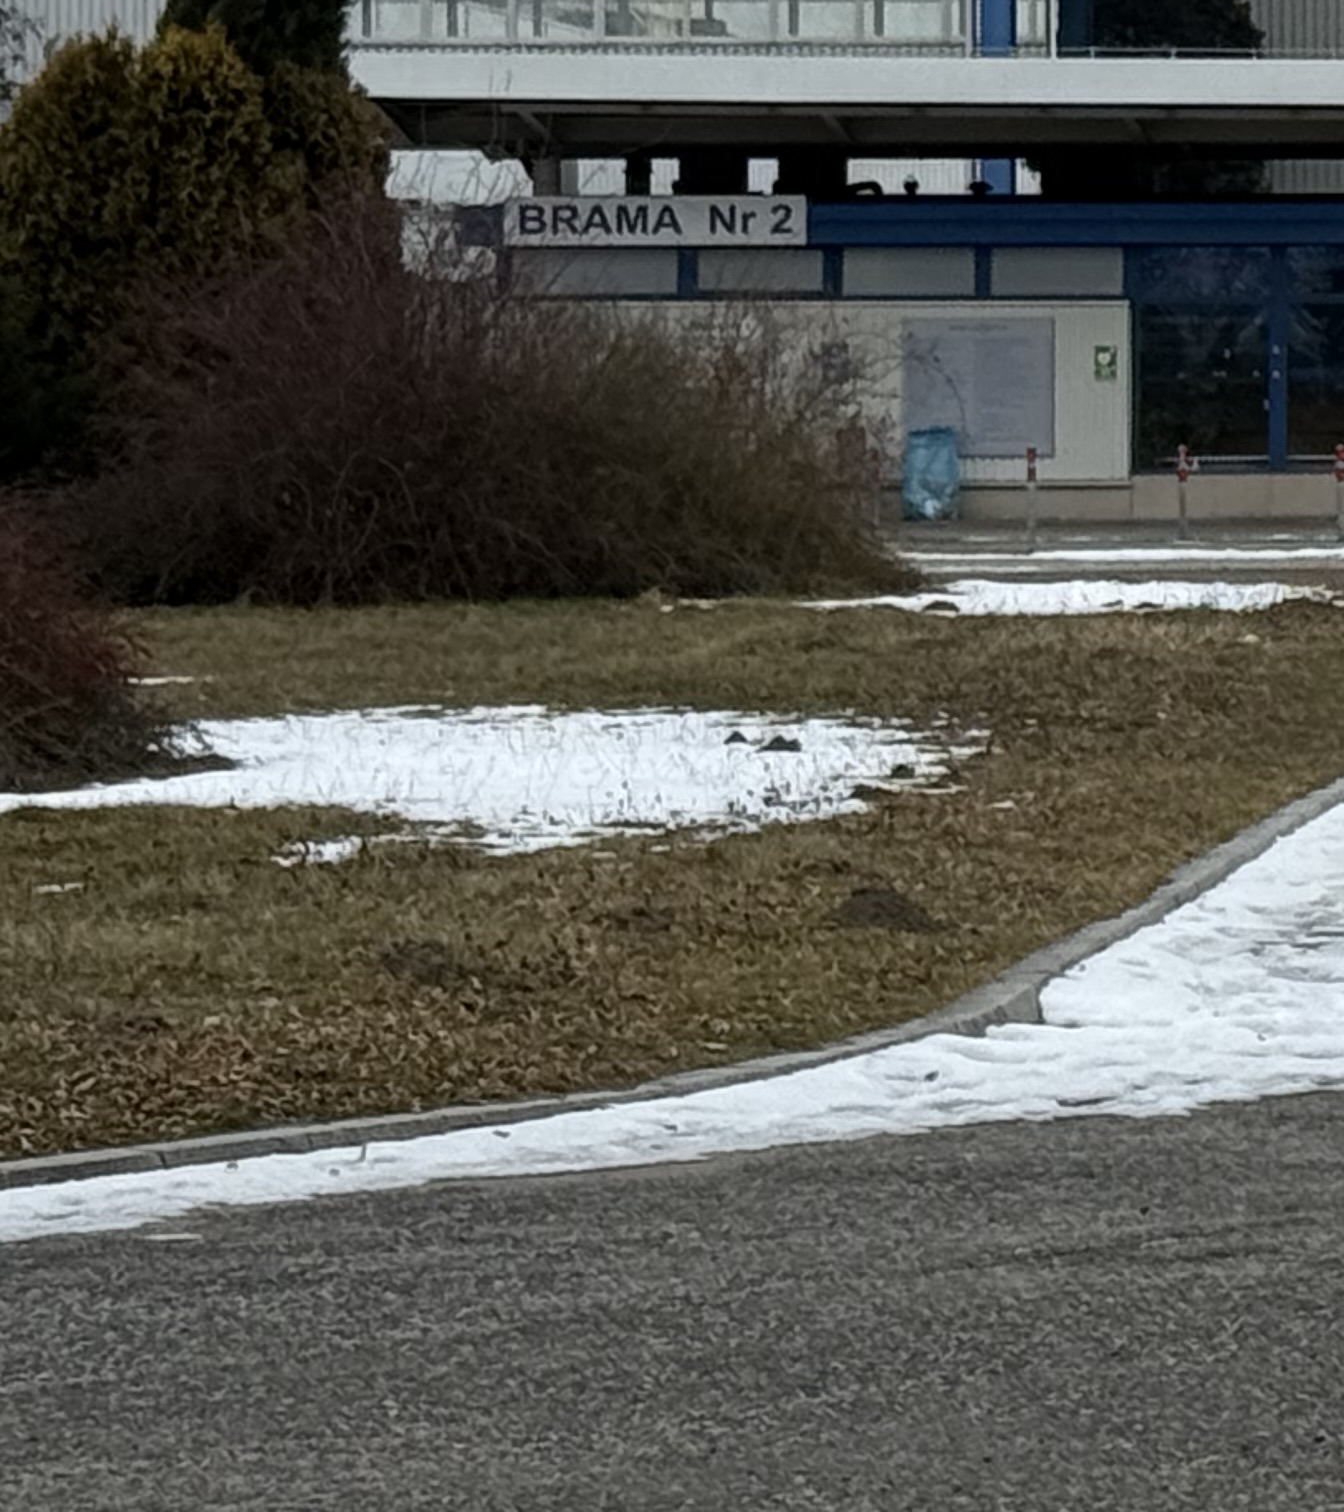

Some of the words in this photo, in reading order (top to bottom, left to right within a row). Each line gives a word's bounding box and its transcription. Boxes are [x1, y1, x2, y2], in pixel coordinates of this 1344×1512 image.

[517, 203, 683, 237] BRAMA
[708, 203, 757, 237] Nr
[769, 203, 794, 235] 2
